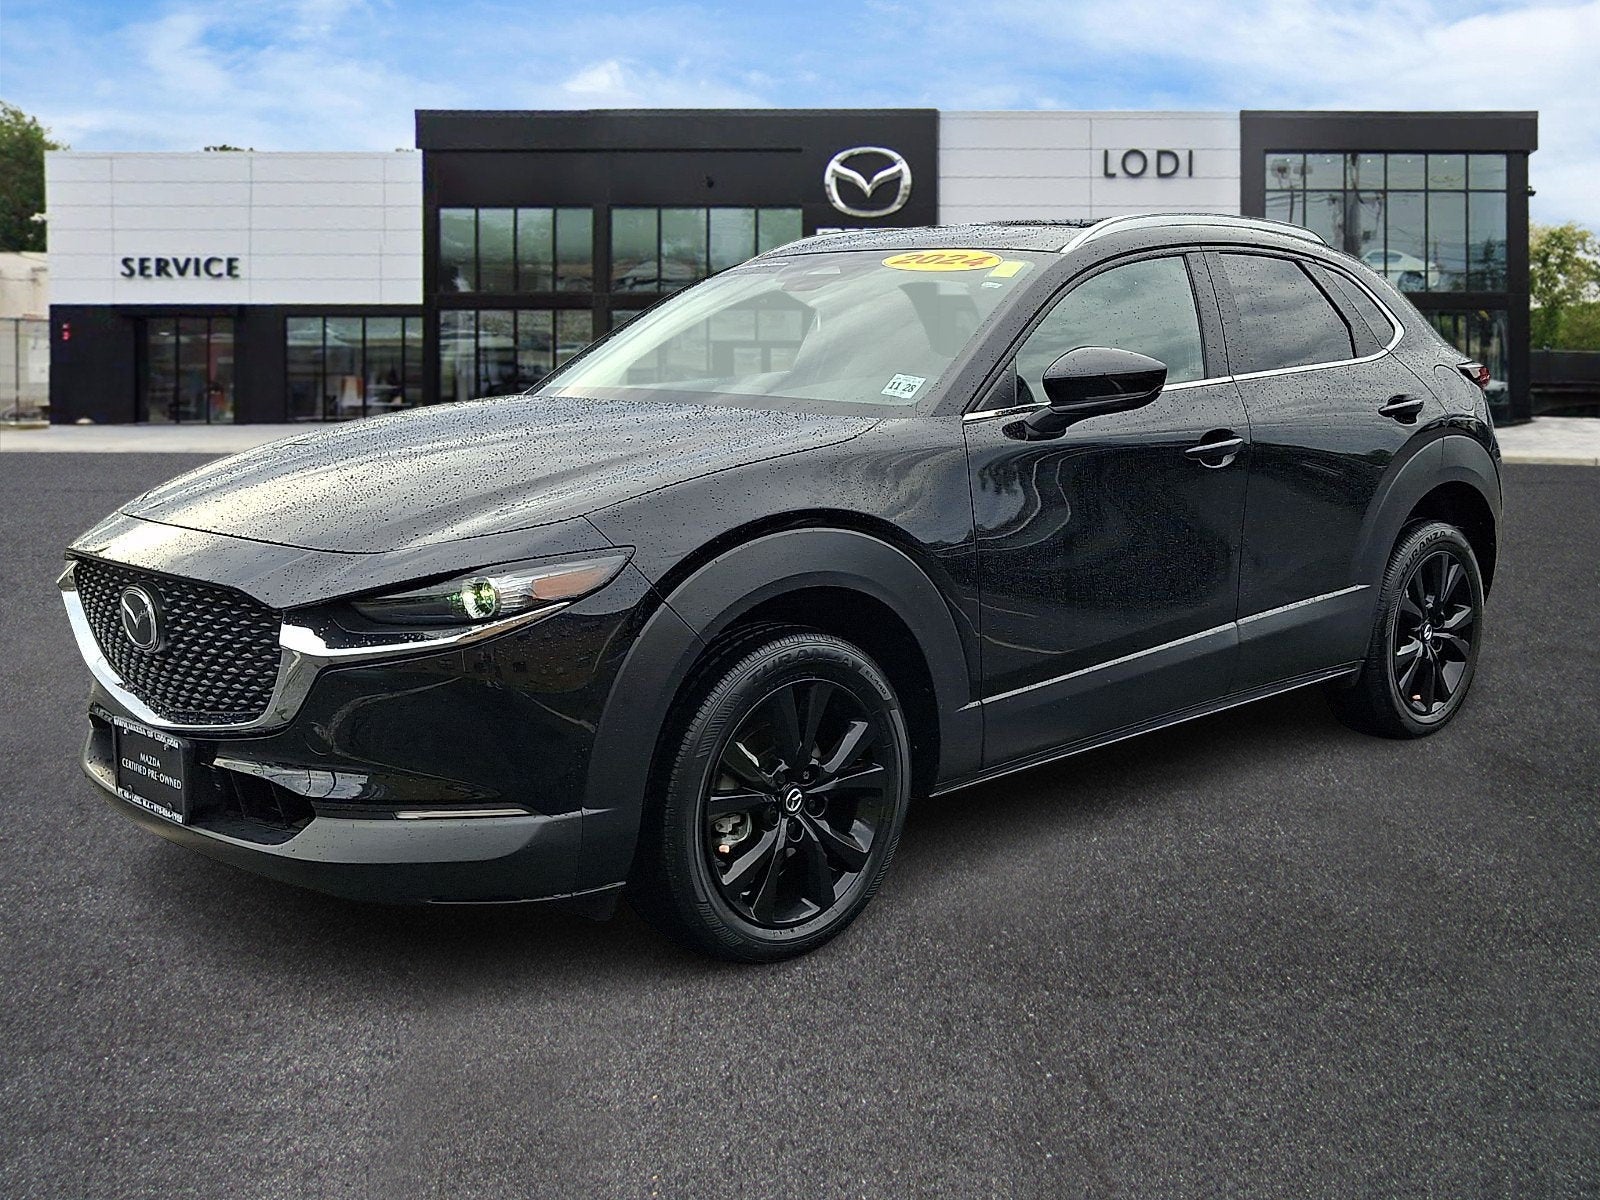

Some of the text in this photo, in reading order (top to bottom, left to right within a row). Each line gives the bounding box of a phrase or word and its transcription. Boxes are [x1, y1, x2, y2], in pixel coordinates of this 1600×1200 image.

[1103, 148, 1194, 179] LODI
[120, 256, 241, 278] SERVICE
[890, 253, 994, 267] 2024
[139, 752, 161, 768] MAZDA
[121, 757, 182, 790] CERTIFIED PRE-OWNED
